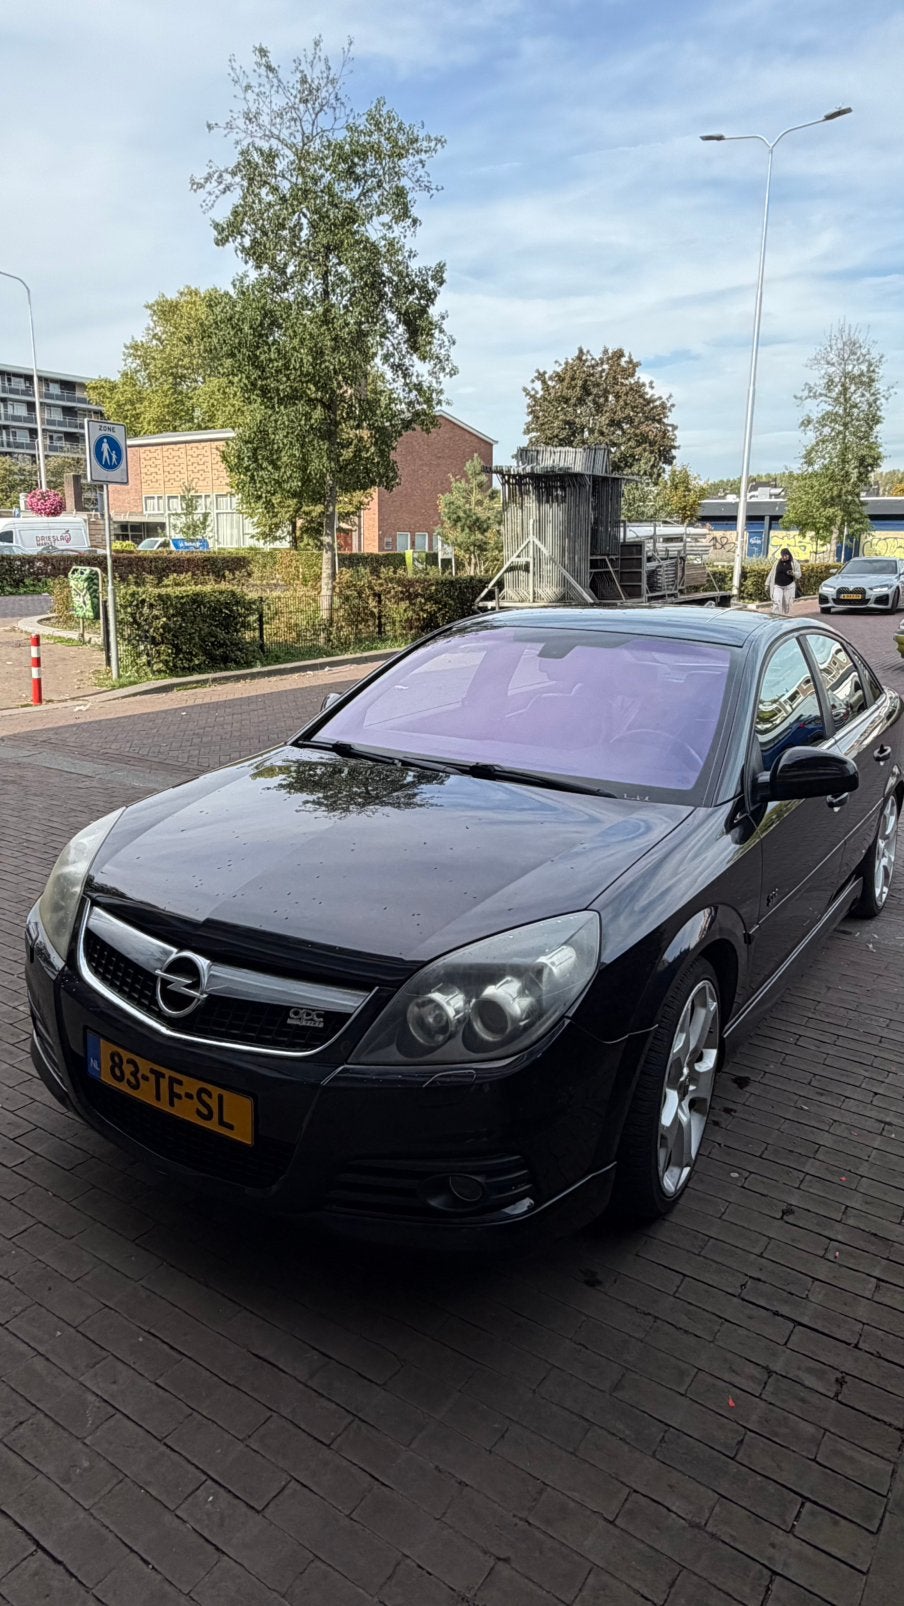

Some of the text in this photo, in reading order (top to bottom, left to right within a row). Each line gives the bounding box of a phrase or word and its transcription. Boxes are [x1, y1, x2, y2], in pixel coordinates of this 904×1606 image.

[98, 425, 116, 433] ZONE
[90, 1059, 100, 1071] NL
[109, 1050, 235, 1131] 83-TF-SL
